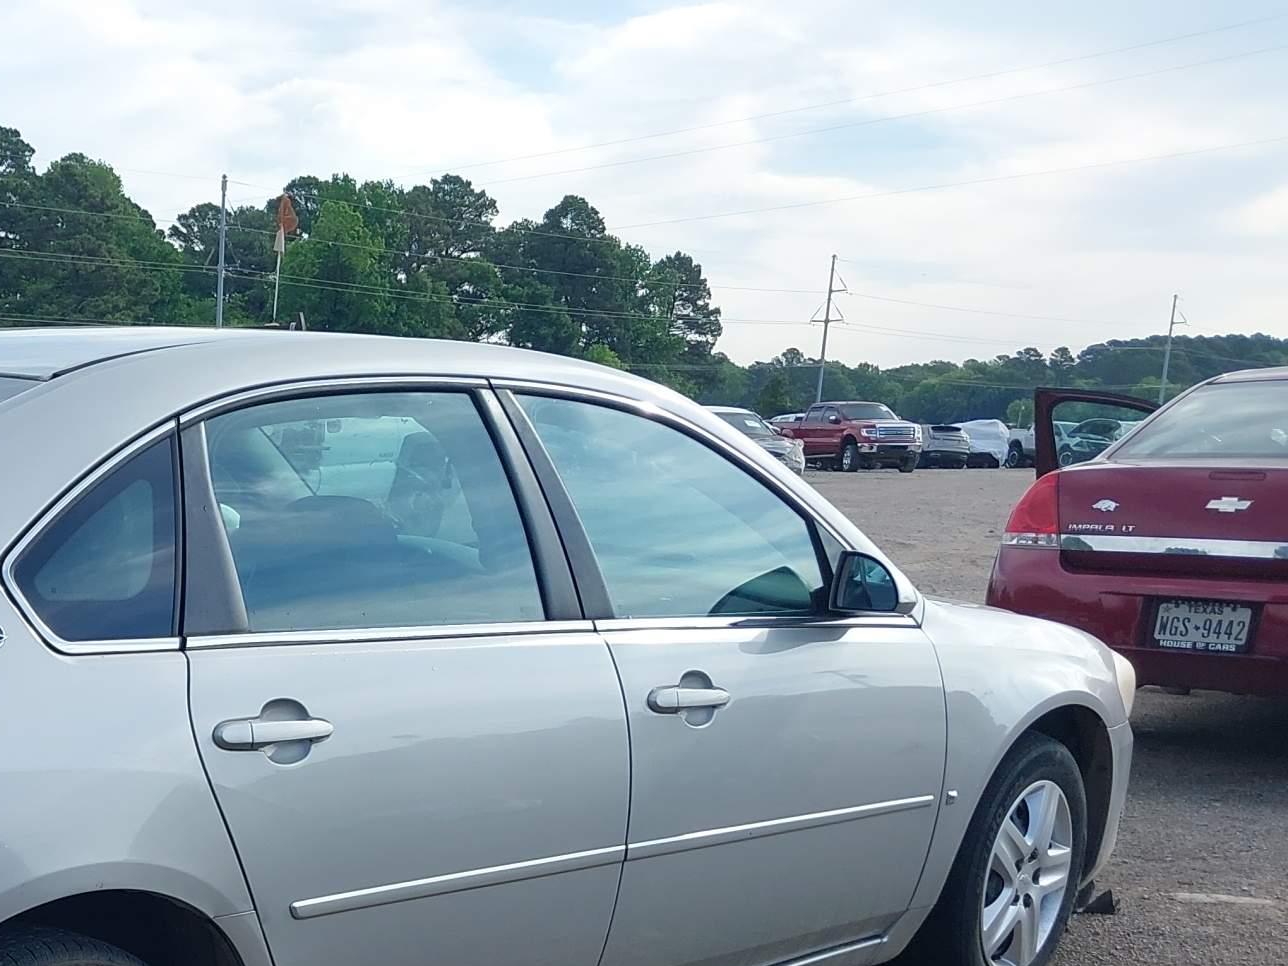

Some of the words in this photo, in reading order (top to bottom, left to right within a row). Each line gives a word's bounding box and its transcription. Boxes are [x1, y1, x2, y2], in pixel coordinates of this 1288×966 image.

[1068, 523, 1115, 532] IMPALA
[1121, 525, 1136, 533] LT
[1188, 605, 1224, 615] TEXAS
[1158, 615, 1191, 637] WGS
[1201, 618, 1246, 640] 9442
[1159, 639, 1193, 649] HOUSE
[1208, 643, 1236, 652] CARS
